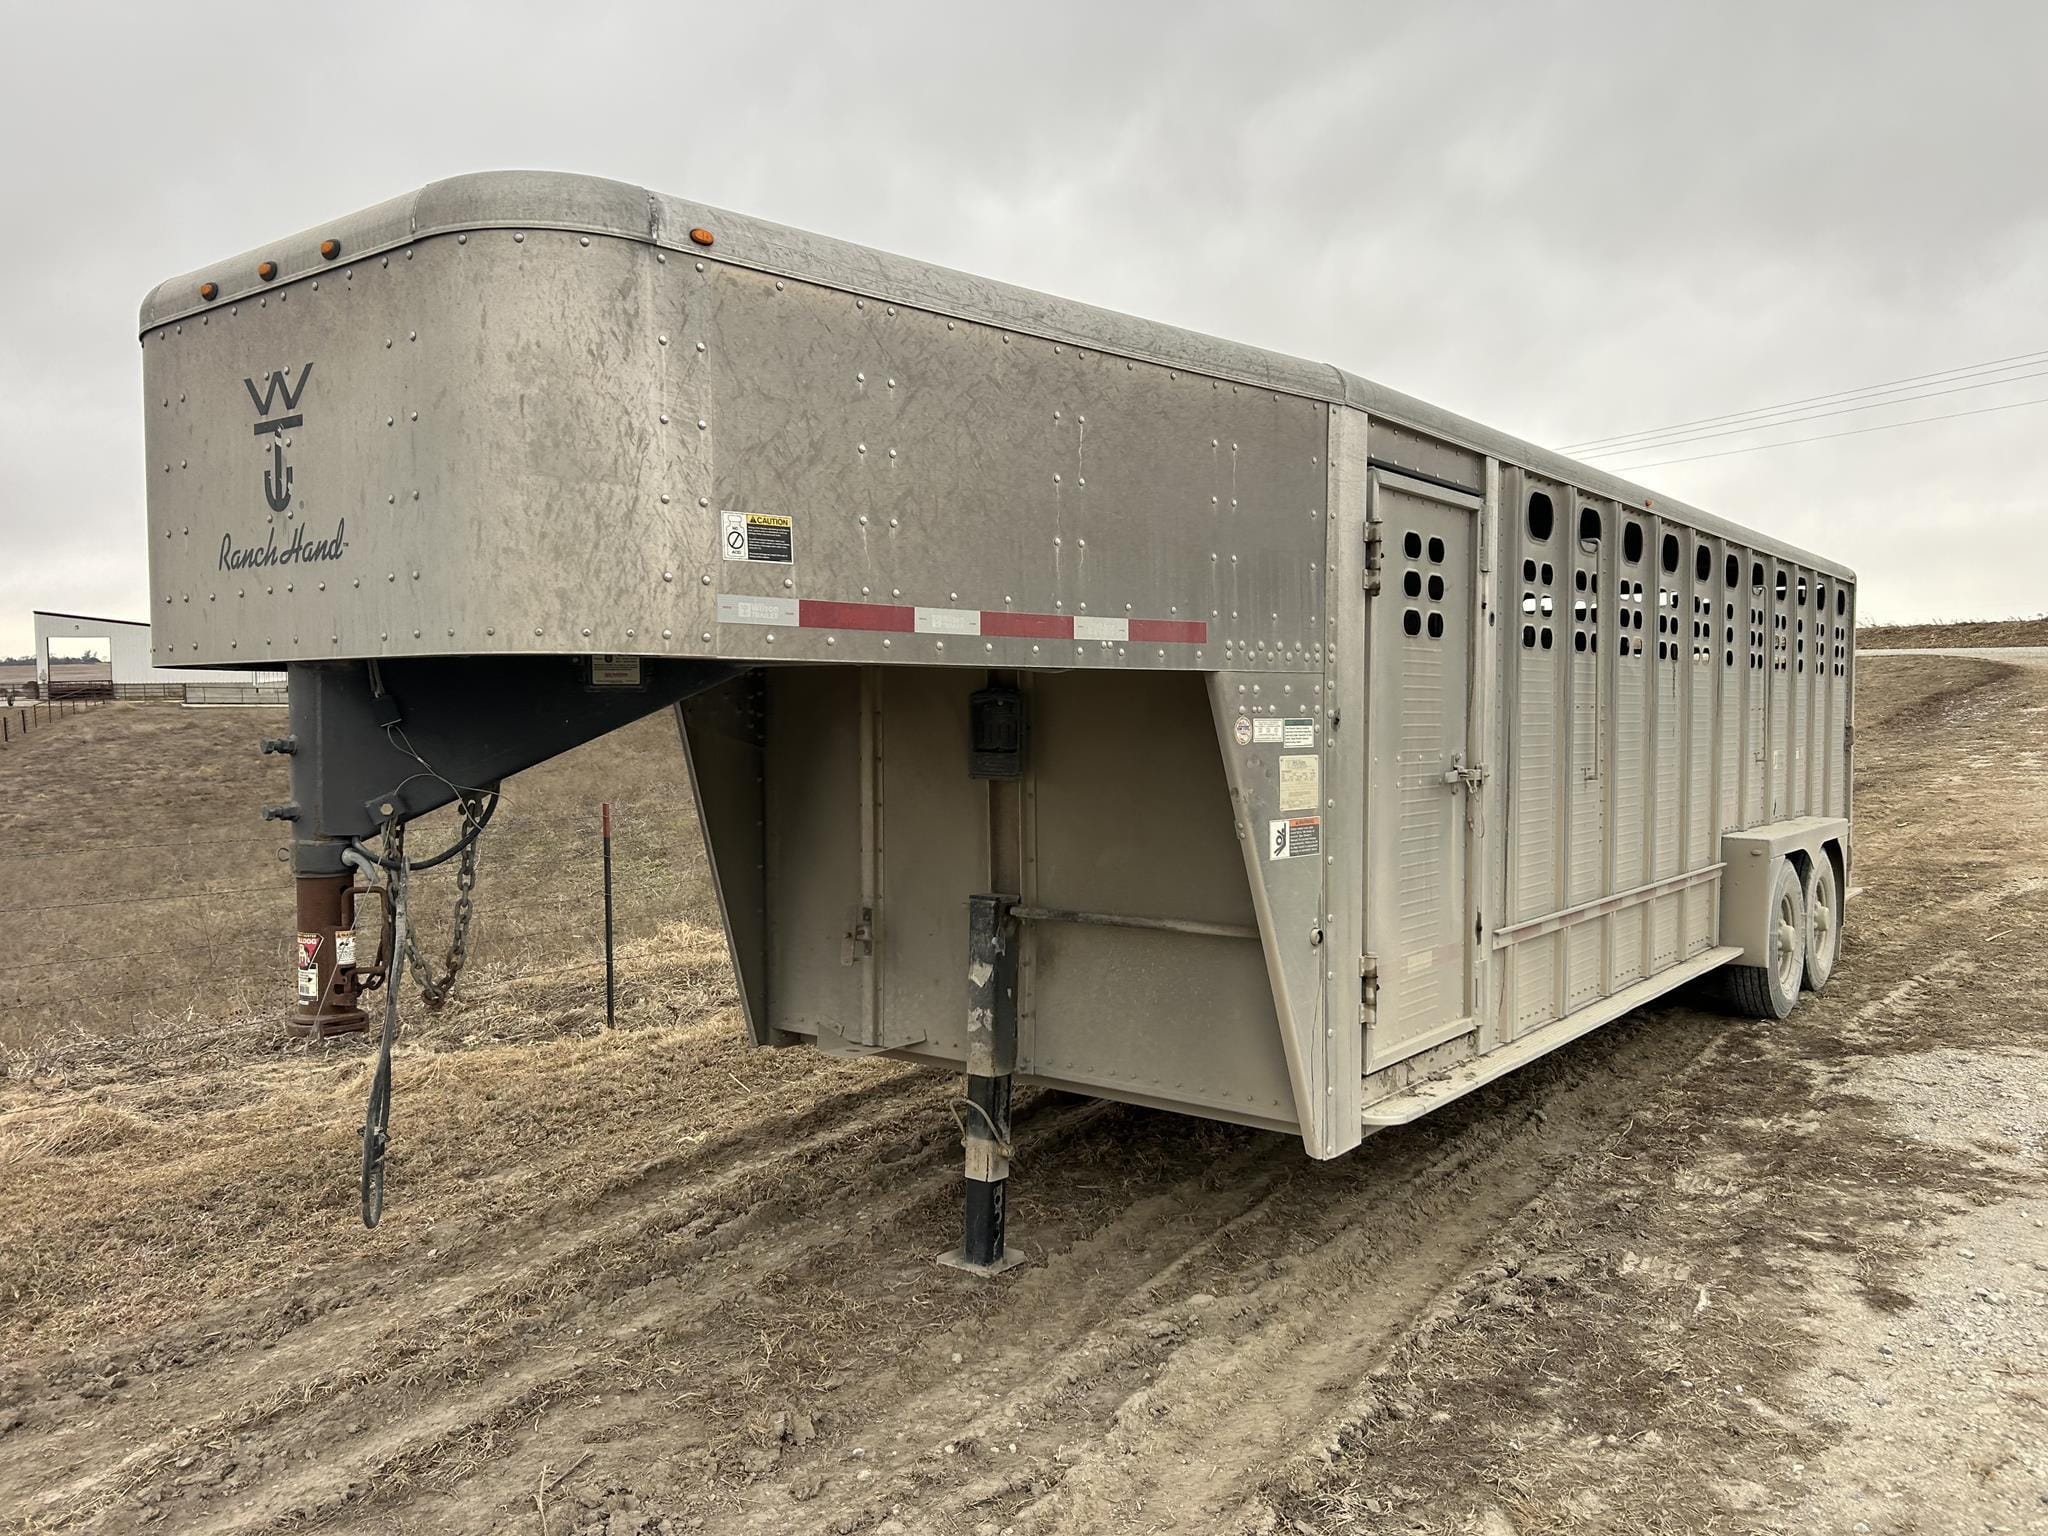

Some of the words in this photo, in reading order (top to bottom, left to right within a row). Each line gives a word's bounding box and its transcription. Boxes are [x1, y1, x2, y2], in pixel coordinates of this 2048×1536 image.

[757, 517, 788, 526] CAUTION
[218, 527, 278, 571] Ranch
[279, 517, 345, 564] Hand
